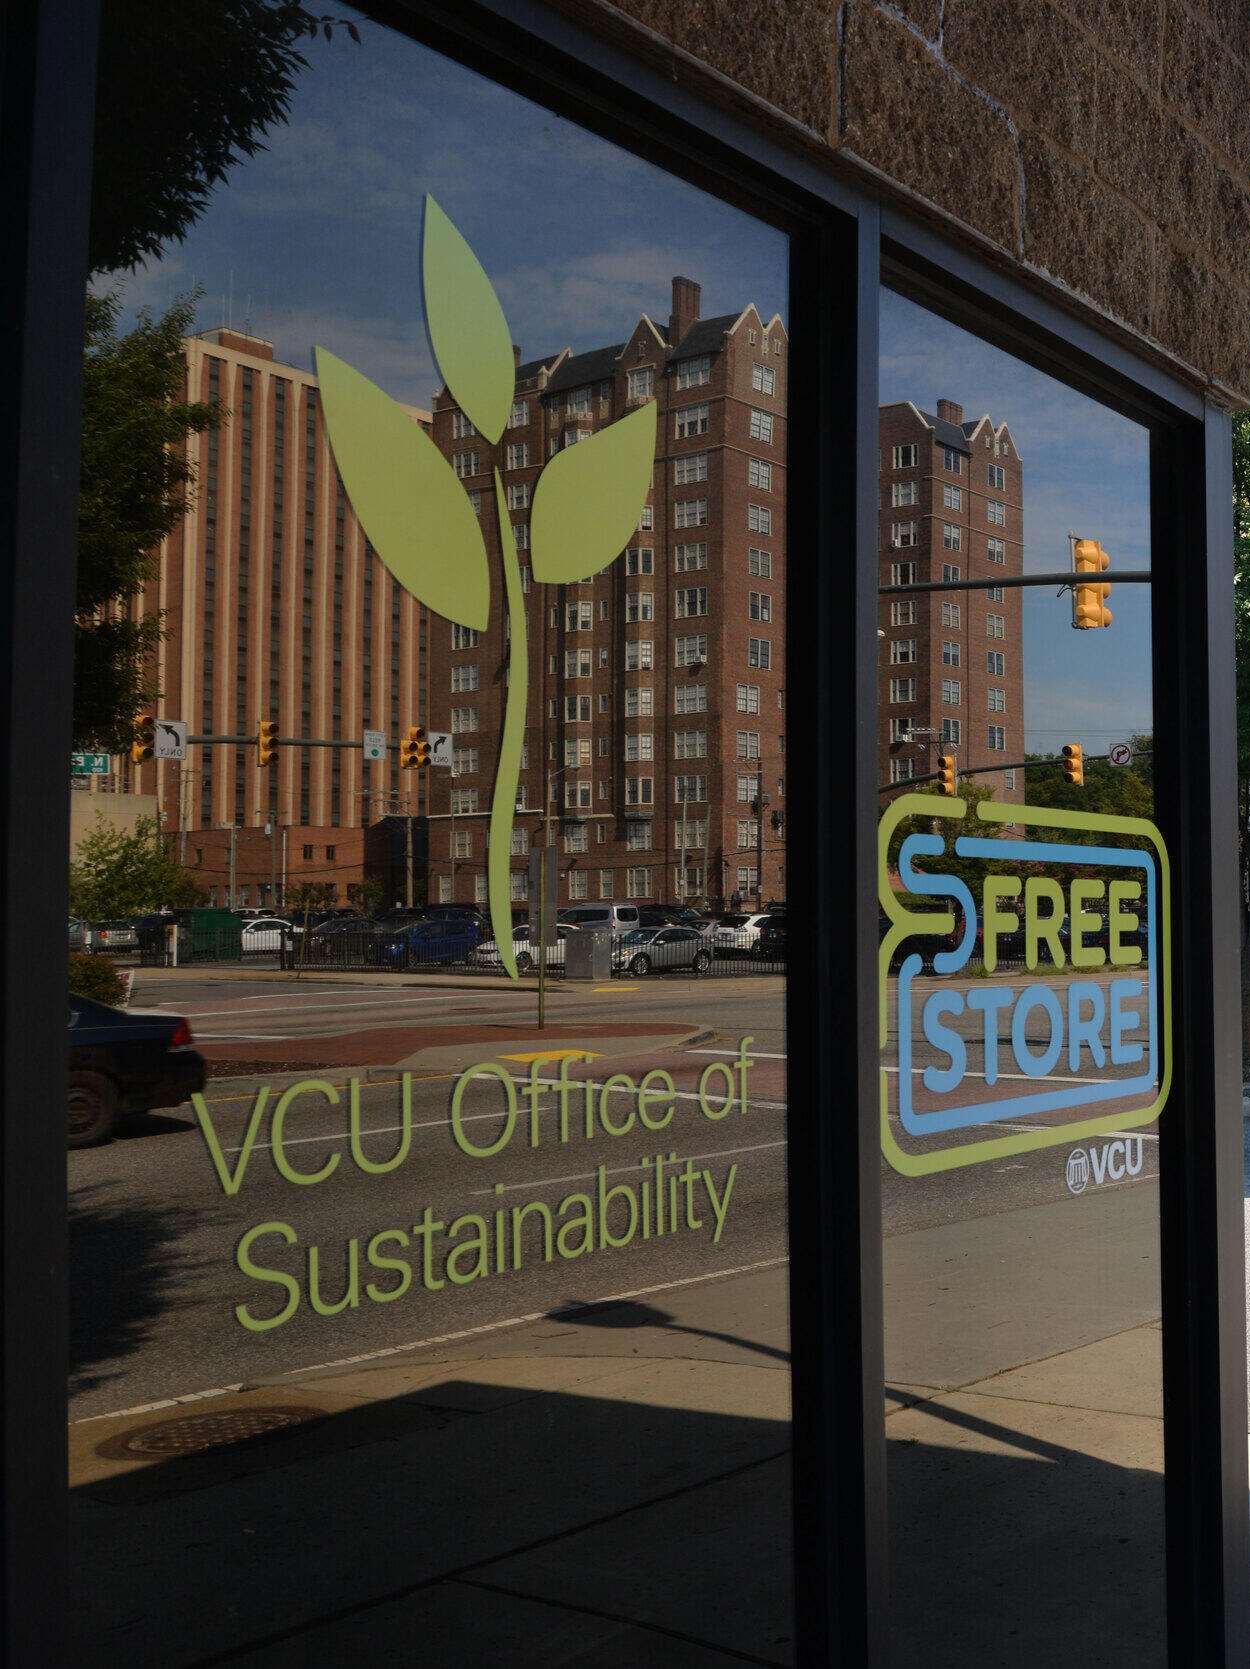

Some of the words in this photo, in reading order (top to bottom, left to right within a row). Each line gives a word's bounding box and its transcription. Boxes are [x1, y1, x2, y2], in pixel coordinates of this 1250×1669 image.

[983, 875, 1143, 973] FREE
[923, 978, 1144, 1094] STORE
[191, 1072, 412, 1195] VCU
[452, 1054, 675, 1158] Office
[700, 1036, 755, 1120] of
[1089, 1136, 1143, 1185] VCU
[235, 1153, 738, 1332] Sustainability
